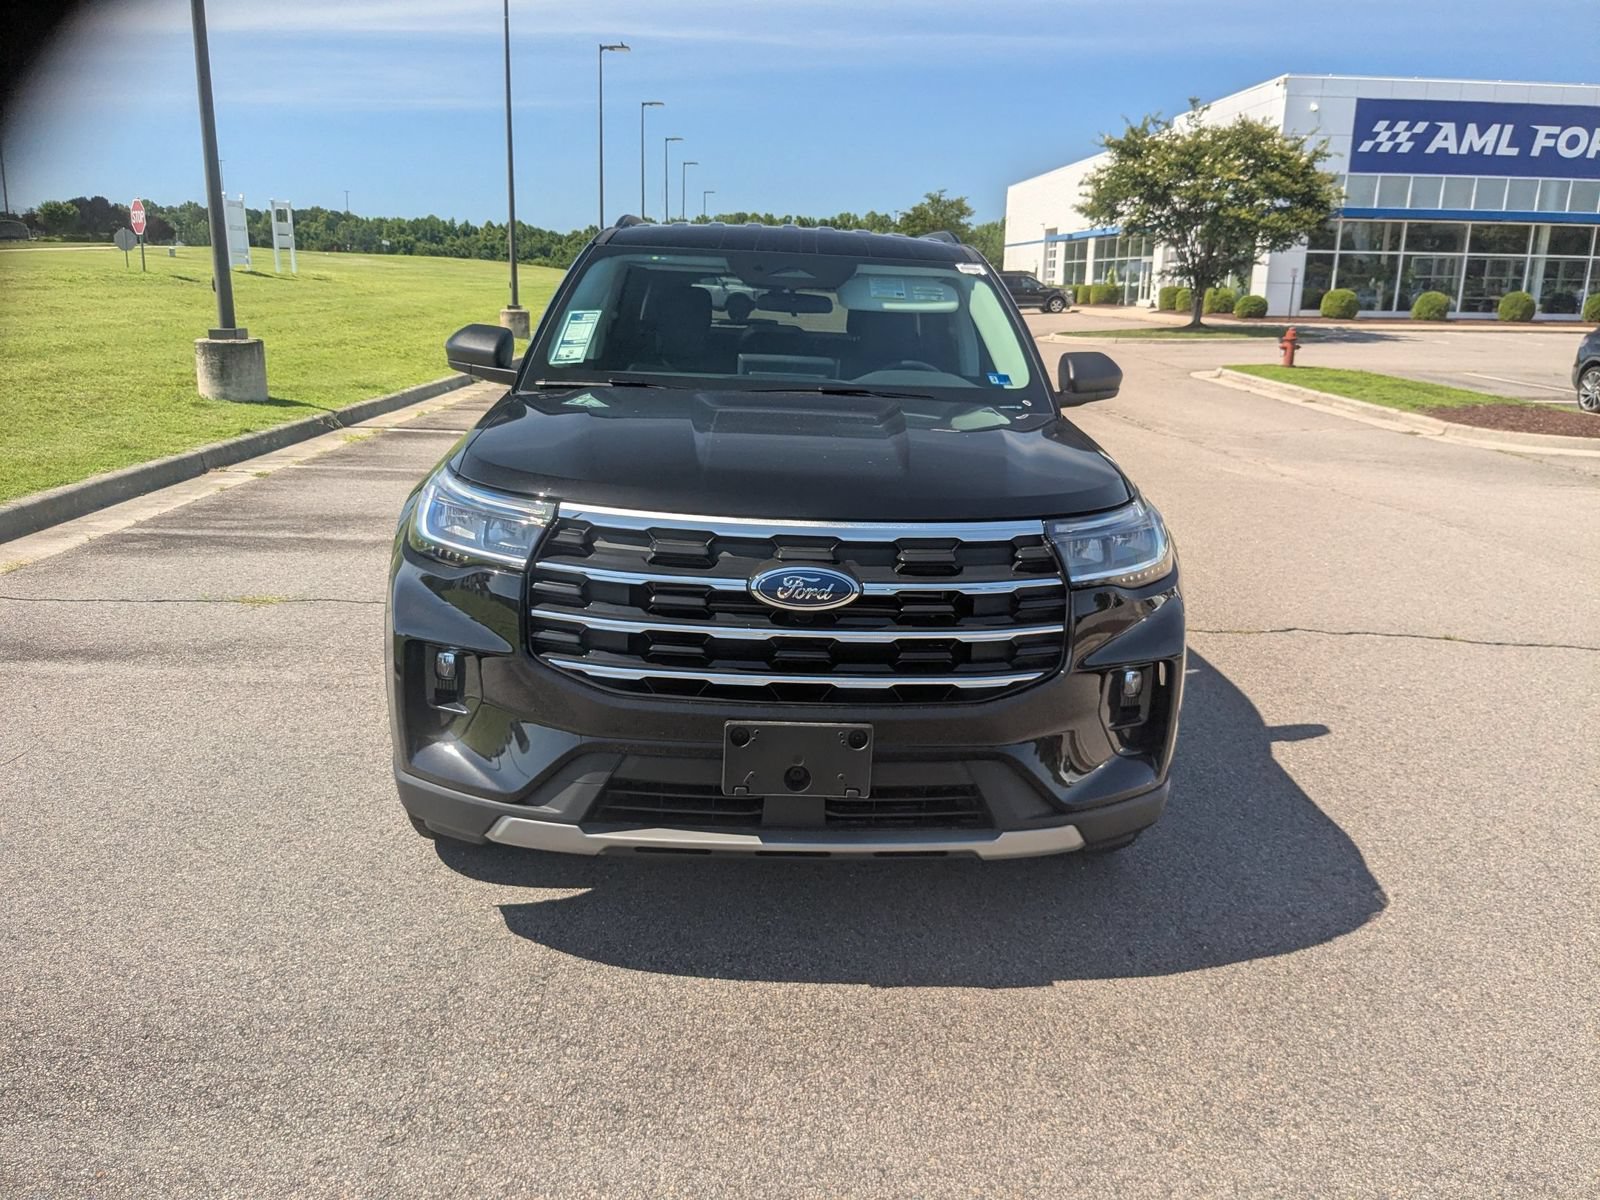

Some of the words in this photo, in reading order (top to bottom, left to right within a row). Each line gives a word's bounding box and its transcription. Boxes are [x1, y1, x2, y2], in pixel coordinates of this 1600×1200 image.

[1424, 121, 1520, 156] AML
[132, 211, 145, 223] STOP
[777, 575, 834, 600] Ford
